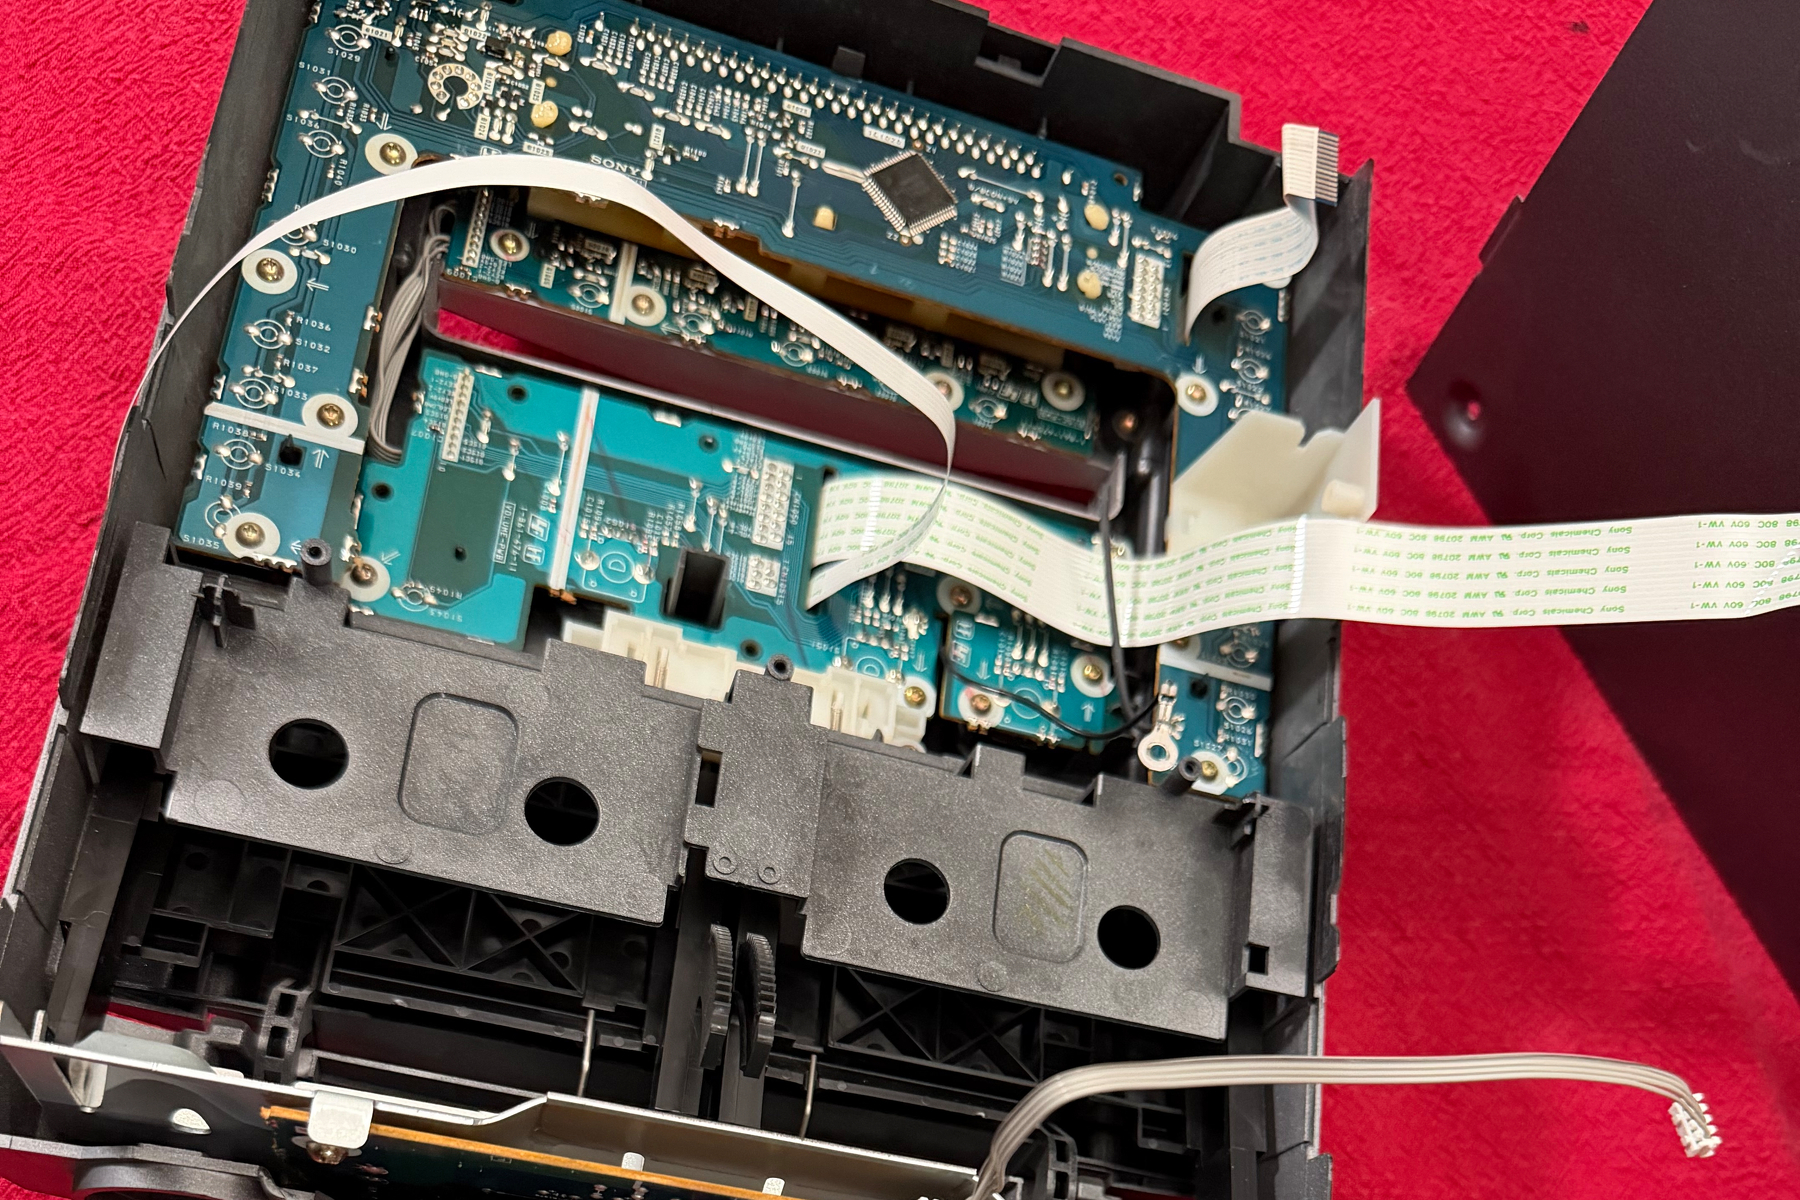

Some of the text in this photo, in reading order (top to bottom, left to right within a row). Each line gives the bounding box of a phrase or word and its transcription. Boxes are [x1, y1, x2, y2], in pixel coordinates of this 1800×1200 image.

[327, 47, 361, 63] S1029
[298, 61, 331, 76] S1031
[286, 114, 320, 130] S1036
[590, 153, 643, 176] SONY
[322, 238, 357, 254] S1030
[297, 316, 331, 331] R1036
[295, 338, 331, 354] S1032
[283, 358, 319, 374] R1037
[272, 385, 308, 401] S1033
[212, 422, 250, 438] R1038
[265, 463, 301, 478] S1034
[205, 475, 242, 491] R1039
[1608, 525, 1634, 535] Sony
[1697, 520, 1778, 529] 80C 60V VW-1
[1549, 528, 1603, 540] Chemicals
[183, 534, 220, 550] S1035
[1695, 540, 1777, 549] 80C 60V VW-1
[1547, 548, 1601, 560] Chemicals
[1606, 545, 1632, 555] Sony
[1604, 565, 1630, 575] Sony
[1693, 561, 1722, 569] VW-1
[1754, 560, 1776, 569] 80C
[1545, 567, 1599, 579] Chemicals
[1602, 585, 1628, 595] Sony
[1692, 581, 1720, 589] VW-1
[1725, 581, 1746, 589] 60V
[1543, 586, 1597, 598] Chemicals
[1600, 605, 1626, 615] Sony
[1690, 601, 1718, 609] VW-1
[1723, 601, 1745, 609] 60V
[1541, 606, 1595, 618] Chemicals
